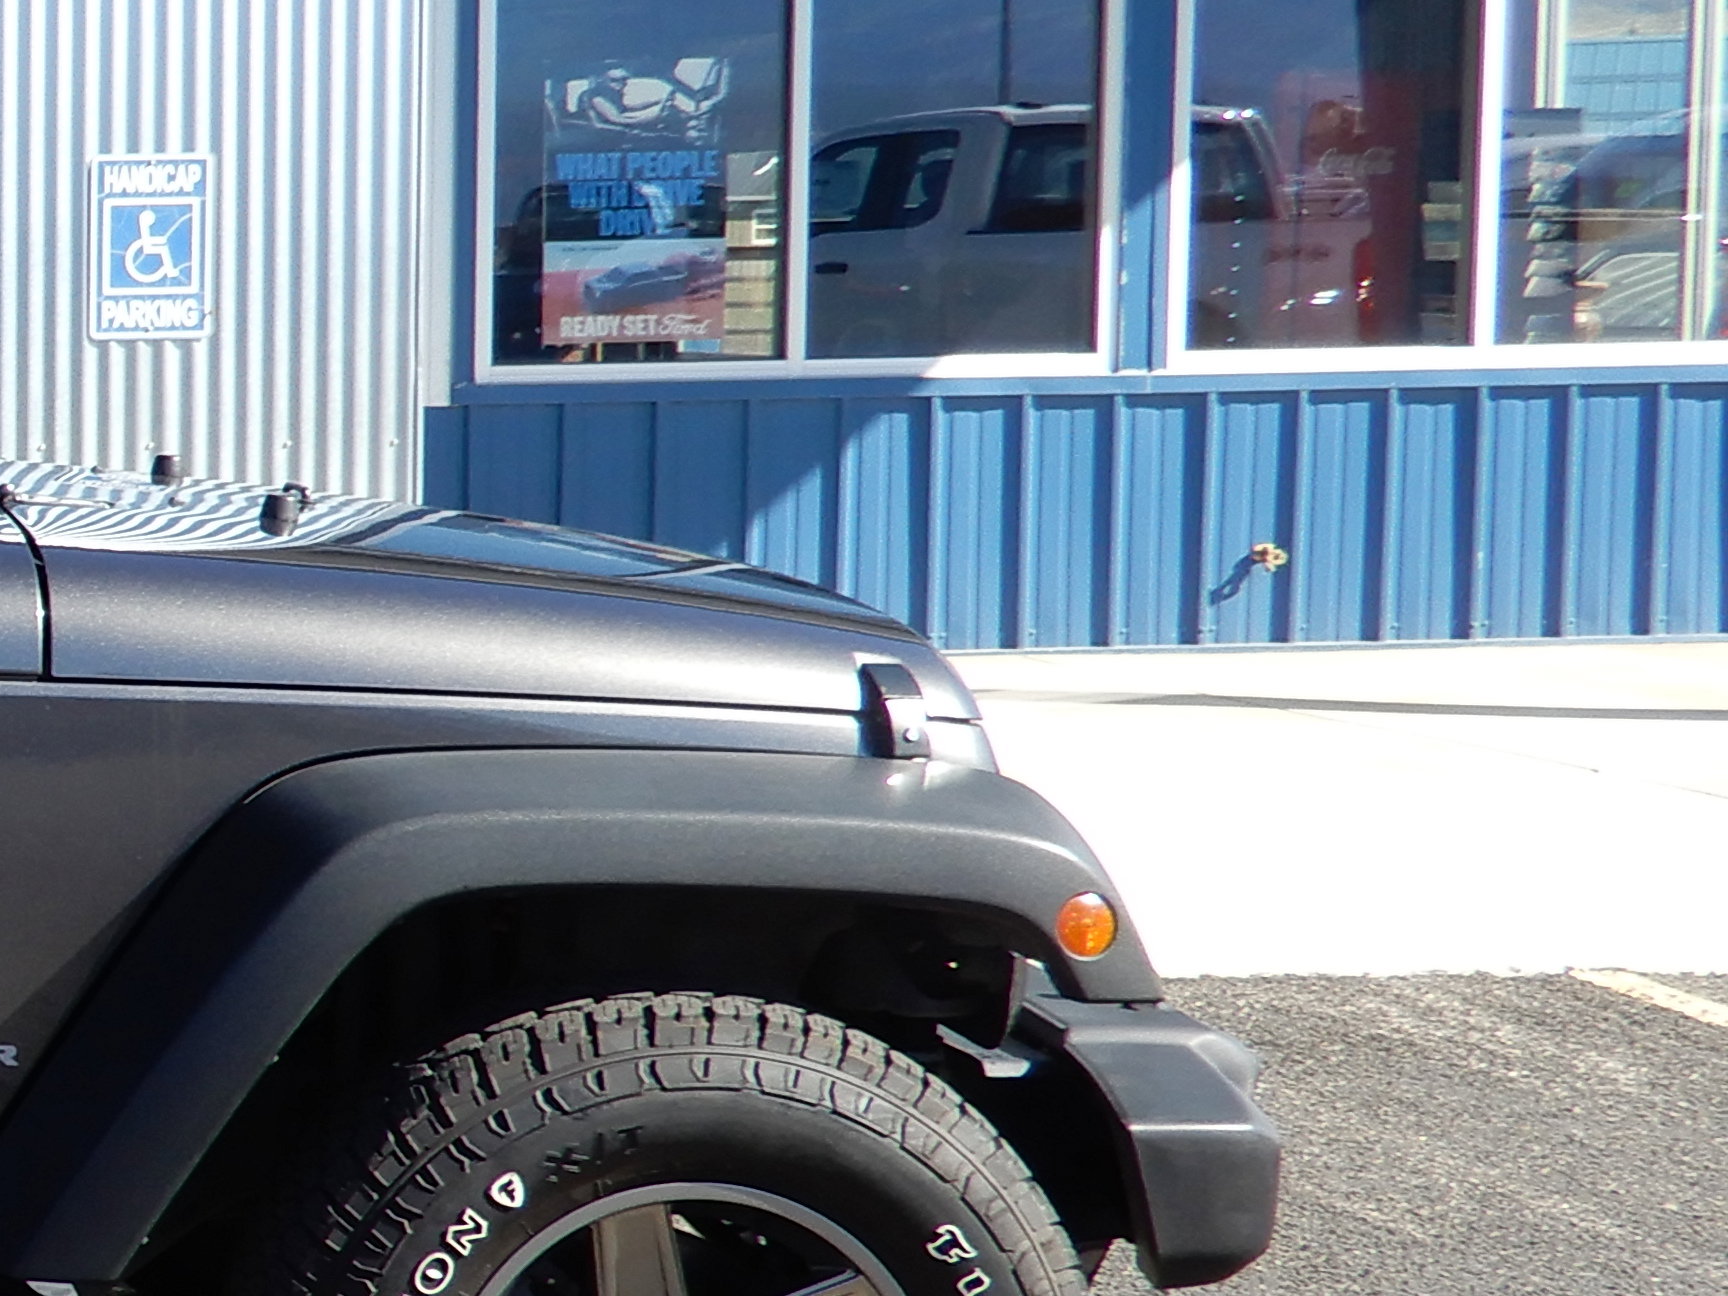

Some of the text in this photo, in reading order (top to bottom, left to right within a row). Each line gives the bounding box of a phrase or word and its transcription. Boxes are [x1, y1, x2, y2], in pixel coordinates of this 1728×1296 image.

[103, 164, 202, 194] HANDICAP
[555, 150, 719, 181] WHAT PEOPLE
[568, 181, 629, 209] WITH
[101, 299, 199, 328] PARKING
[560, 314, 713, 338] READY SET Ford
